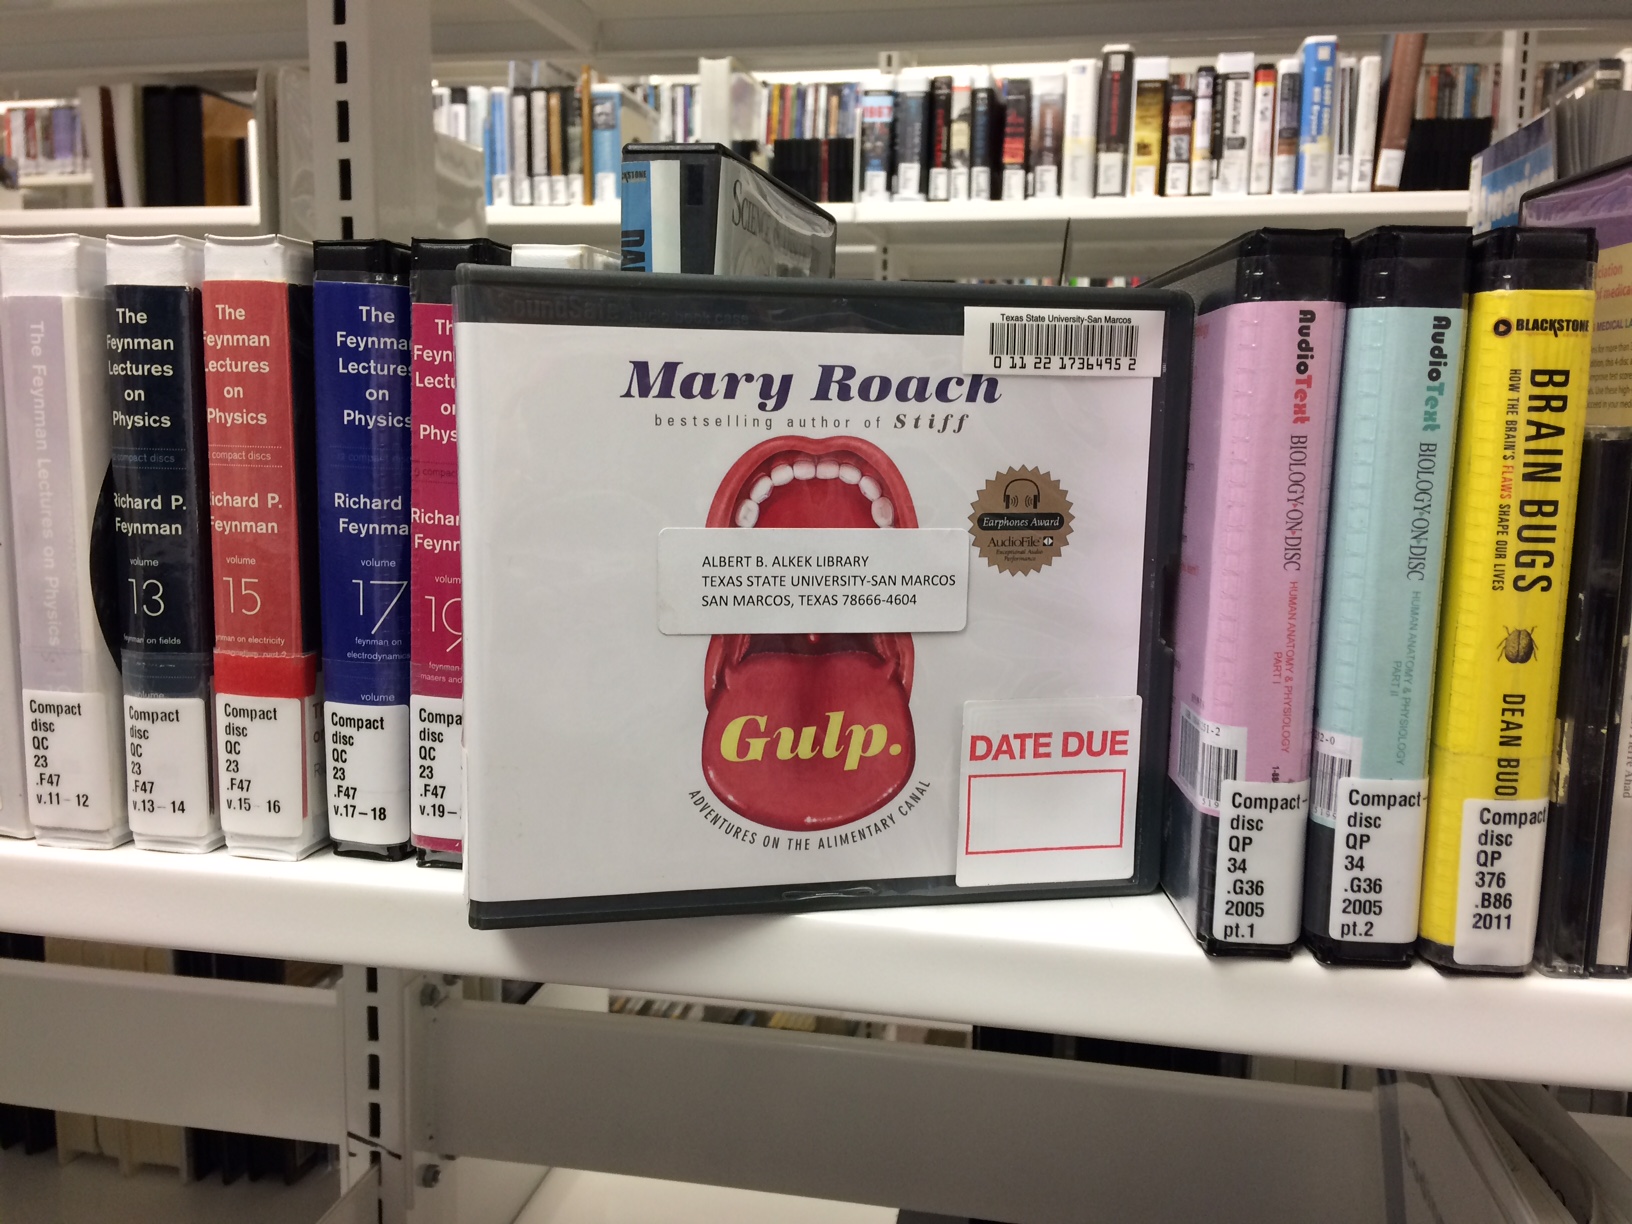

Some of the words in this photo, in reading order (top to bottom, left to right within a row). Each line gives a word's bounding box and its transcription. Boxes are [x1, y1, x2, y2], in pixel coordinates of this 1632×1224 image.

[116, 308, 148, 324] The
[215, 305, 245, 320] The
[359, 305, 395, 323] The
[1000, 314, 1023, 322] Texas
[1026, 314, 1045, 322] State
[1048, 315, 1102, 325] University-San
[1104, 316, 1132, 324] Marcos
[1516, 319, 1589, 337] BLACKSTONE
[29, 320, 45, 357] The
[107, 335, 174, 352] Feynman
[109, 360, 173, 376] Lectures
[1009, 356, 1026, 369] 11
[1034, 357, 1051, 369] 22
[1059, 357, 1121, 370] 1736495
[1128, 358, 1136, 370] 2
[1292, 309, 1317, 425] AudioText
[1422, 315, 1452, 433] AudioText
[1508, 369, 1522, 392] HOW
[224, 386, 243, 398] on
[619, 360, 794, 413] Mary
[809, 364, 1002, 404] Roach
[124, 389, 144, 401] on
[365, 389, 389, 401] on
[31, 364, 47, 450] Feynman
[1506, 397, 1519, 416] THE
[112, 410, 171, 429] Physics
[207, 408, 267, 426] Physics
[654, 414, 773, 431] bestselling
[786, 416, 851, 429] author
[863, 416, 881, 429] of
[893, 413, 970, 434] Stiff
[1521, 369, 1571, 482] BRAIN
[150, 453, 175, 463] discs
[212, 451, 245, 461] compact
[248, 453, 271, 461] discs
[1500, 465, 1514, 499] FLAWS
[37, 458, 54, 539] Lectures
[171, 495, 186, 510] P.
[210, 492, 258, 508] ichard
[268, 493, 282, 508] P.
[334, 492, 402, 510] Richard
[115, 517, 182, 536] Feynman
[983, 517, 1029, 529] Earphones
[1030, 517, 1060, 526] Award
[1497, 504, 1511, 536] SHAPE
[1495, 541, 1508, 559] OUR
[1513, 500, 1559, 592] BUGS
[130, 558, 158, 566] volume
[226, 555, 256, 565] volume
[360, 558, 396, 567] volume
[702, 555, 752, 568] ALBERT
[756, 555, 768, 568] B.
[771, 555, 813, 568] ALKEK
[816, 555, 869, 568] LIBRARY
[701, 575, 743, 588] TEXAS
[746, 575, 786, 588] STATE
[790, 574, 898, 588] UNIVERSITY-SAN
[900, 574, 956, 587] MARCOS
[1492, 564, 1507, 591] LIVES
[128, 578, 164, 616] 13
[223, 577, 261, 615] 15
[701, 594, 729, 608] SAN
[732, 594, 795, 609] MARCOS,
[798, 594, 839, 607] TEXAS
[841, 593, 918, 607] 78666-4604
[1288, 581, 1298, 620] HUMAN
[44, 577, 61, 646] Physics
[352, 580, 408, 634] 17
[1409, 591, 1421, 630] HUMAN
[159, 637, 181, 645] fields
[248, 635, 285, 646] electricity
[355, 637, 389, 646] feynman
[1285, 622, 1296, 673] ANATOMY
[1273, 652, 1282, 678] PART
[1404, 633, 1417, 685] ANATOMY
[421, 673, 445, 682] masers
[1391, 661, 1402, 687] PART
[361, 693, 395, 701] volume
[29, 700, 81, 716] Compact
[129, 706, 180, 724] Compact
[224, 703, 277, 722] Compact
[31, 718, 55, 732] disc
[331, 712, 384, 731] Compact
[1280, 685, 1293, 754] PHYSIOLOGY
[1499, 694, 1526, 747] DEAN
[130, 725, 149, 740] disc
[225, 722, 248, 737] disc
[419, 728, 443, 743] disc
[1396, 697, 1411, 766] PHYSIOLOGY
[32, 736, 49, 750] QC
[332, 731, 354, 746] disc
[720, 710, 902, 771] Gulp.
[969, 732, 1053, 762] DATE
[1061, 729, 1129, 758] DUE
[130, 742, 142, 758] QC
[225, 741, 240, 755] QC
[332, 748, 347, 763] QC
[419, 746, 436, 761] QC
[34, 755, 48, 768] 23
[131, 761, 142, 775] 23
[226, 759, 239, 773] 23
[36, 773, 60, 786] .F47
[333, 766, 345, 781] 23
[419, 765, 434, 780] 23
[132, 780, 154, 794] .F47
[227, 778, 251, 792] .F47
[334, 785, 357, 800] .F47
[420, 784, 446, 799] .F47
[688, 789, 758, 845] ADVENTURES
[762, 835, 780, 850] ON
[787, 838, 810, 851] THE
[817, 813, 896, 850] ALIMENTARY
[897, 779, 931, 817] CANAL
[1347, 812, 1382, 829] disc
[1480, 807, 1546, 828] Compact
[1230, 815, 1264, 832] disc
[1229, 836, 1253, 852] QP
[1346, 834, 1371, 850] QP
[1478, 830, 1513, 847] disc
[1227, 858, 1247, 874] 34
[1344, 855, 1365, 872] 34
[1476, 850, 1502, 867] QP
[1227, 880, 1264, 896] .G36
[1344, 878, 1383, 894] .G36
[1475, 872, 1506, 888] 376
[1225, 901, 1265, 917] 2005
[1342, 899, 1383, 916] 2005
[1475, 893, 1512, 909] .B86
[1341, 921, 1374, 938] pt.2
[1472, 913, 1512, 930] 2011
[1224, 922, 1255, 940] pt.1
